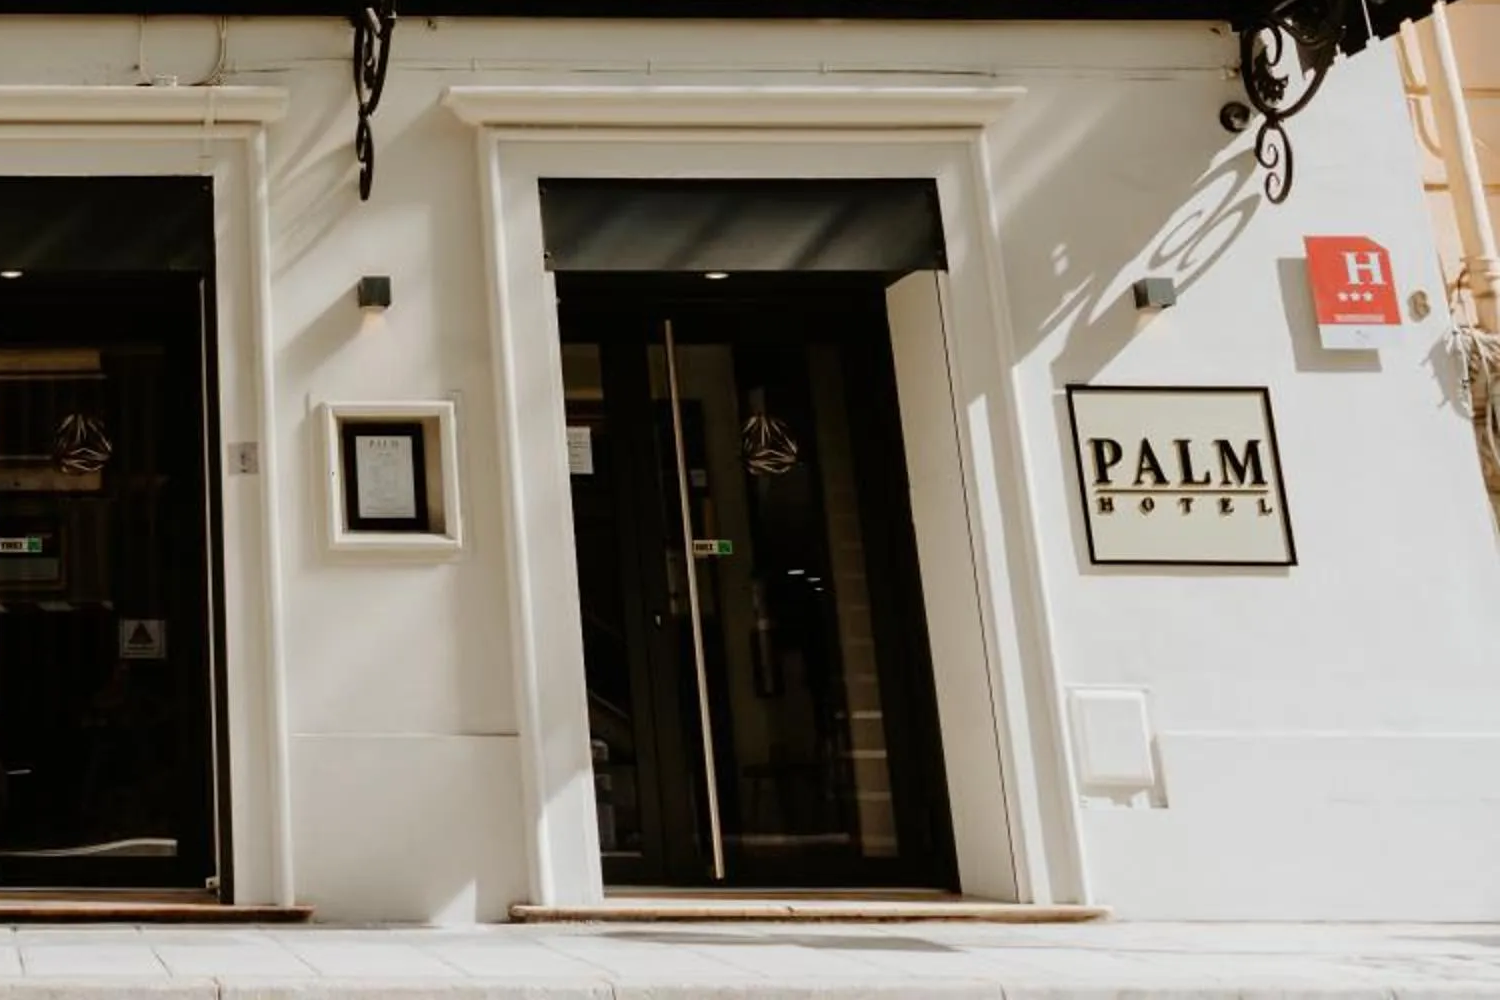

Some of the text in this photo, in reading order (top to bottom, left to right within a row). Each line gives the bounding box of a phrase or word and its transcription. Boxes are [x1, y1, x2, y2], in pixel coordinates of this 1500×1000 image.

[1341, 251, 1386, 285] H
[1088, 437, 1268, 486] PALM
[1096, 497, 1273, 516] HOTEL
